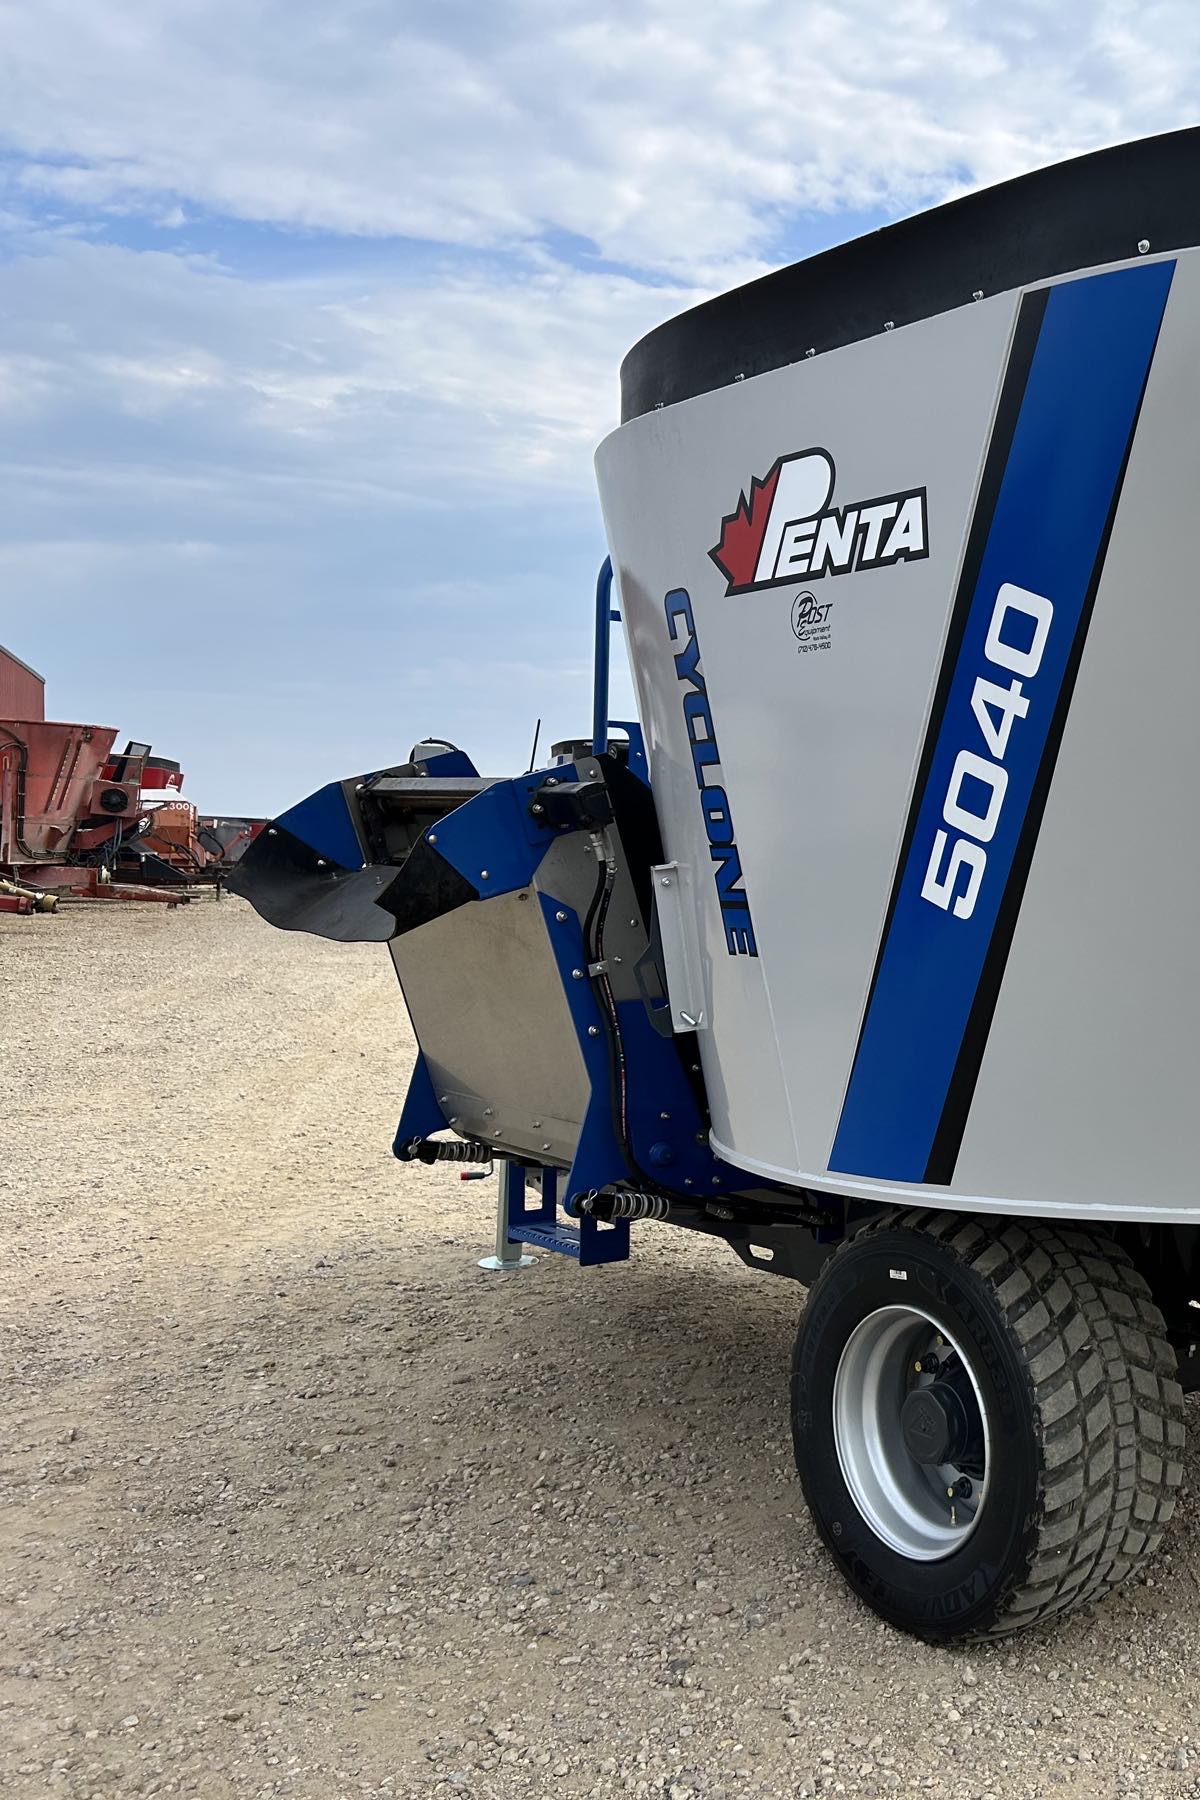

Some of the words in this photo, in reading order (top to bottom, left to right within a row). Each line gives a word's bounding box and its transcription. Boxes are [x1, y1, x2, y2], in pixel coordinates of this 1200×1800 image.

[752, 447, 929, 584] PENTA
[663, 586, 759, 958] CYCLONE
[920, 581, 1054, 920] 5040
